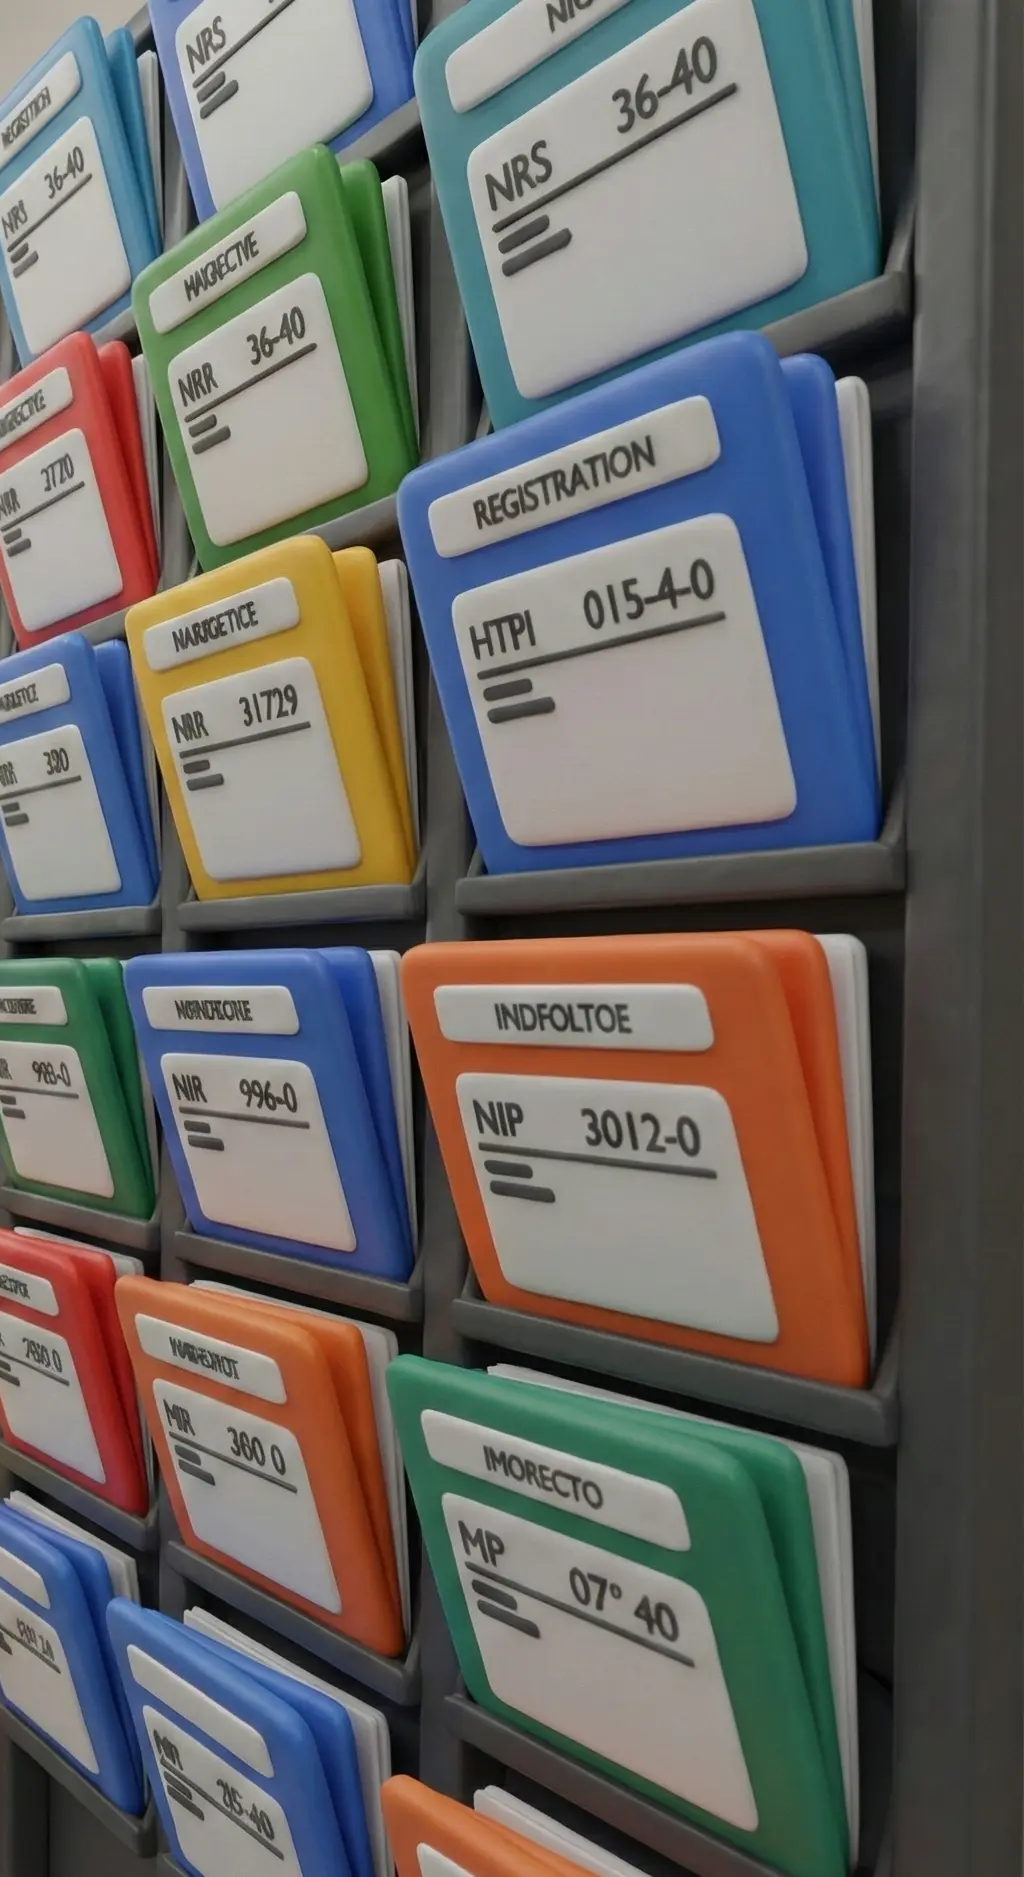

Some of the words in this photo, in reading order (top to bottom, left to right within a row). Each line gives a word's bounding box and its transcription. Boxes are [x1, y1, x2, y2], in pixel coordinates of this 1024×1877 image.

[185, 15, 226, 74] NRS
[484, 139, 553, 212] NRS
[611, 35, 718, 134] 36-40
[44, 146, 85, 200] 36-40
[177, 362, 219, 408] NRR
[245, 306, 306, 366] 36-40
[473, 434, 657, 530] REGISTRATION
[238, 683, 298, 727] 31729
[494, 1002, 633, 1034] INDFOLTOE
[171, 1072, 208, 1104] NIR
[239, 1078, 298, 1114] 996-0
[472, 1098, 525, 1137] NIP
[580, 1107, 702, 1158] 3012-0
[482, 1445, 605, 1511] IMORECTO
[458, 1519, 506, 1568] MP
[633, 1594, 680, 1642] 40
